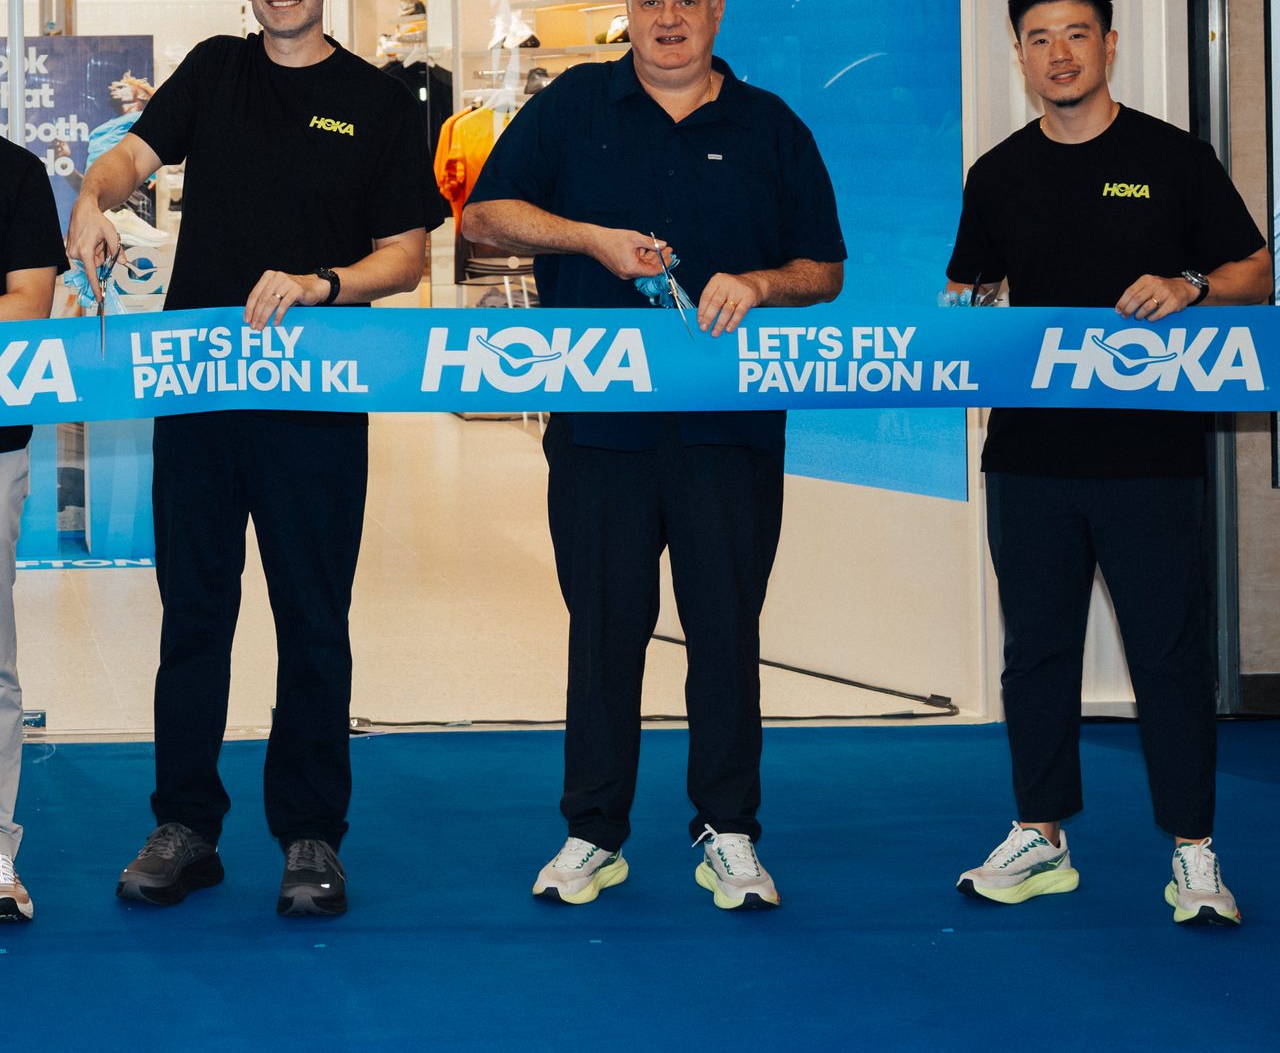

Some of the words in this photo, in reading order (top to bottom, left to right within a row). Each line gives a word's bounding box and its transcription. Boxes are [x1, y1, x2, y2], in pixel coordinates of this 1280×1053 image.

[309, 116, 354, 136] HOKA
[1102, 183, 1150, 198] HOKA
[131, 326, 232, 365] LET'S
[241, 326, 304, 359] FLY
[421, 327, 653, 394] HOKA
[738, 326, 844, 360] LET'S
[852, 326, 917, 360] FLY
[1030, 326, 1266, 392] HOKA
[132, 359, 311, 399] PAVILION
[322, 360, 369, 393] KL
[738, 359, 922, 393] PAVILION
[933, 360, 979, 392] KL
